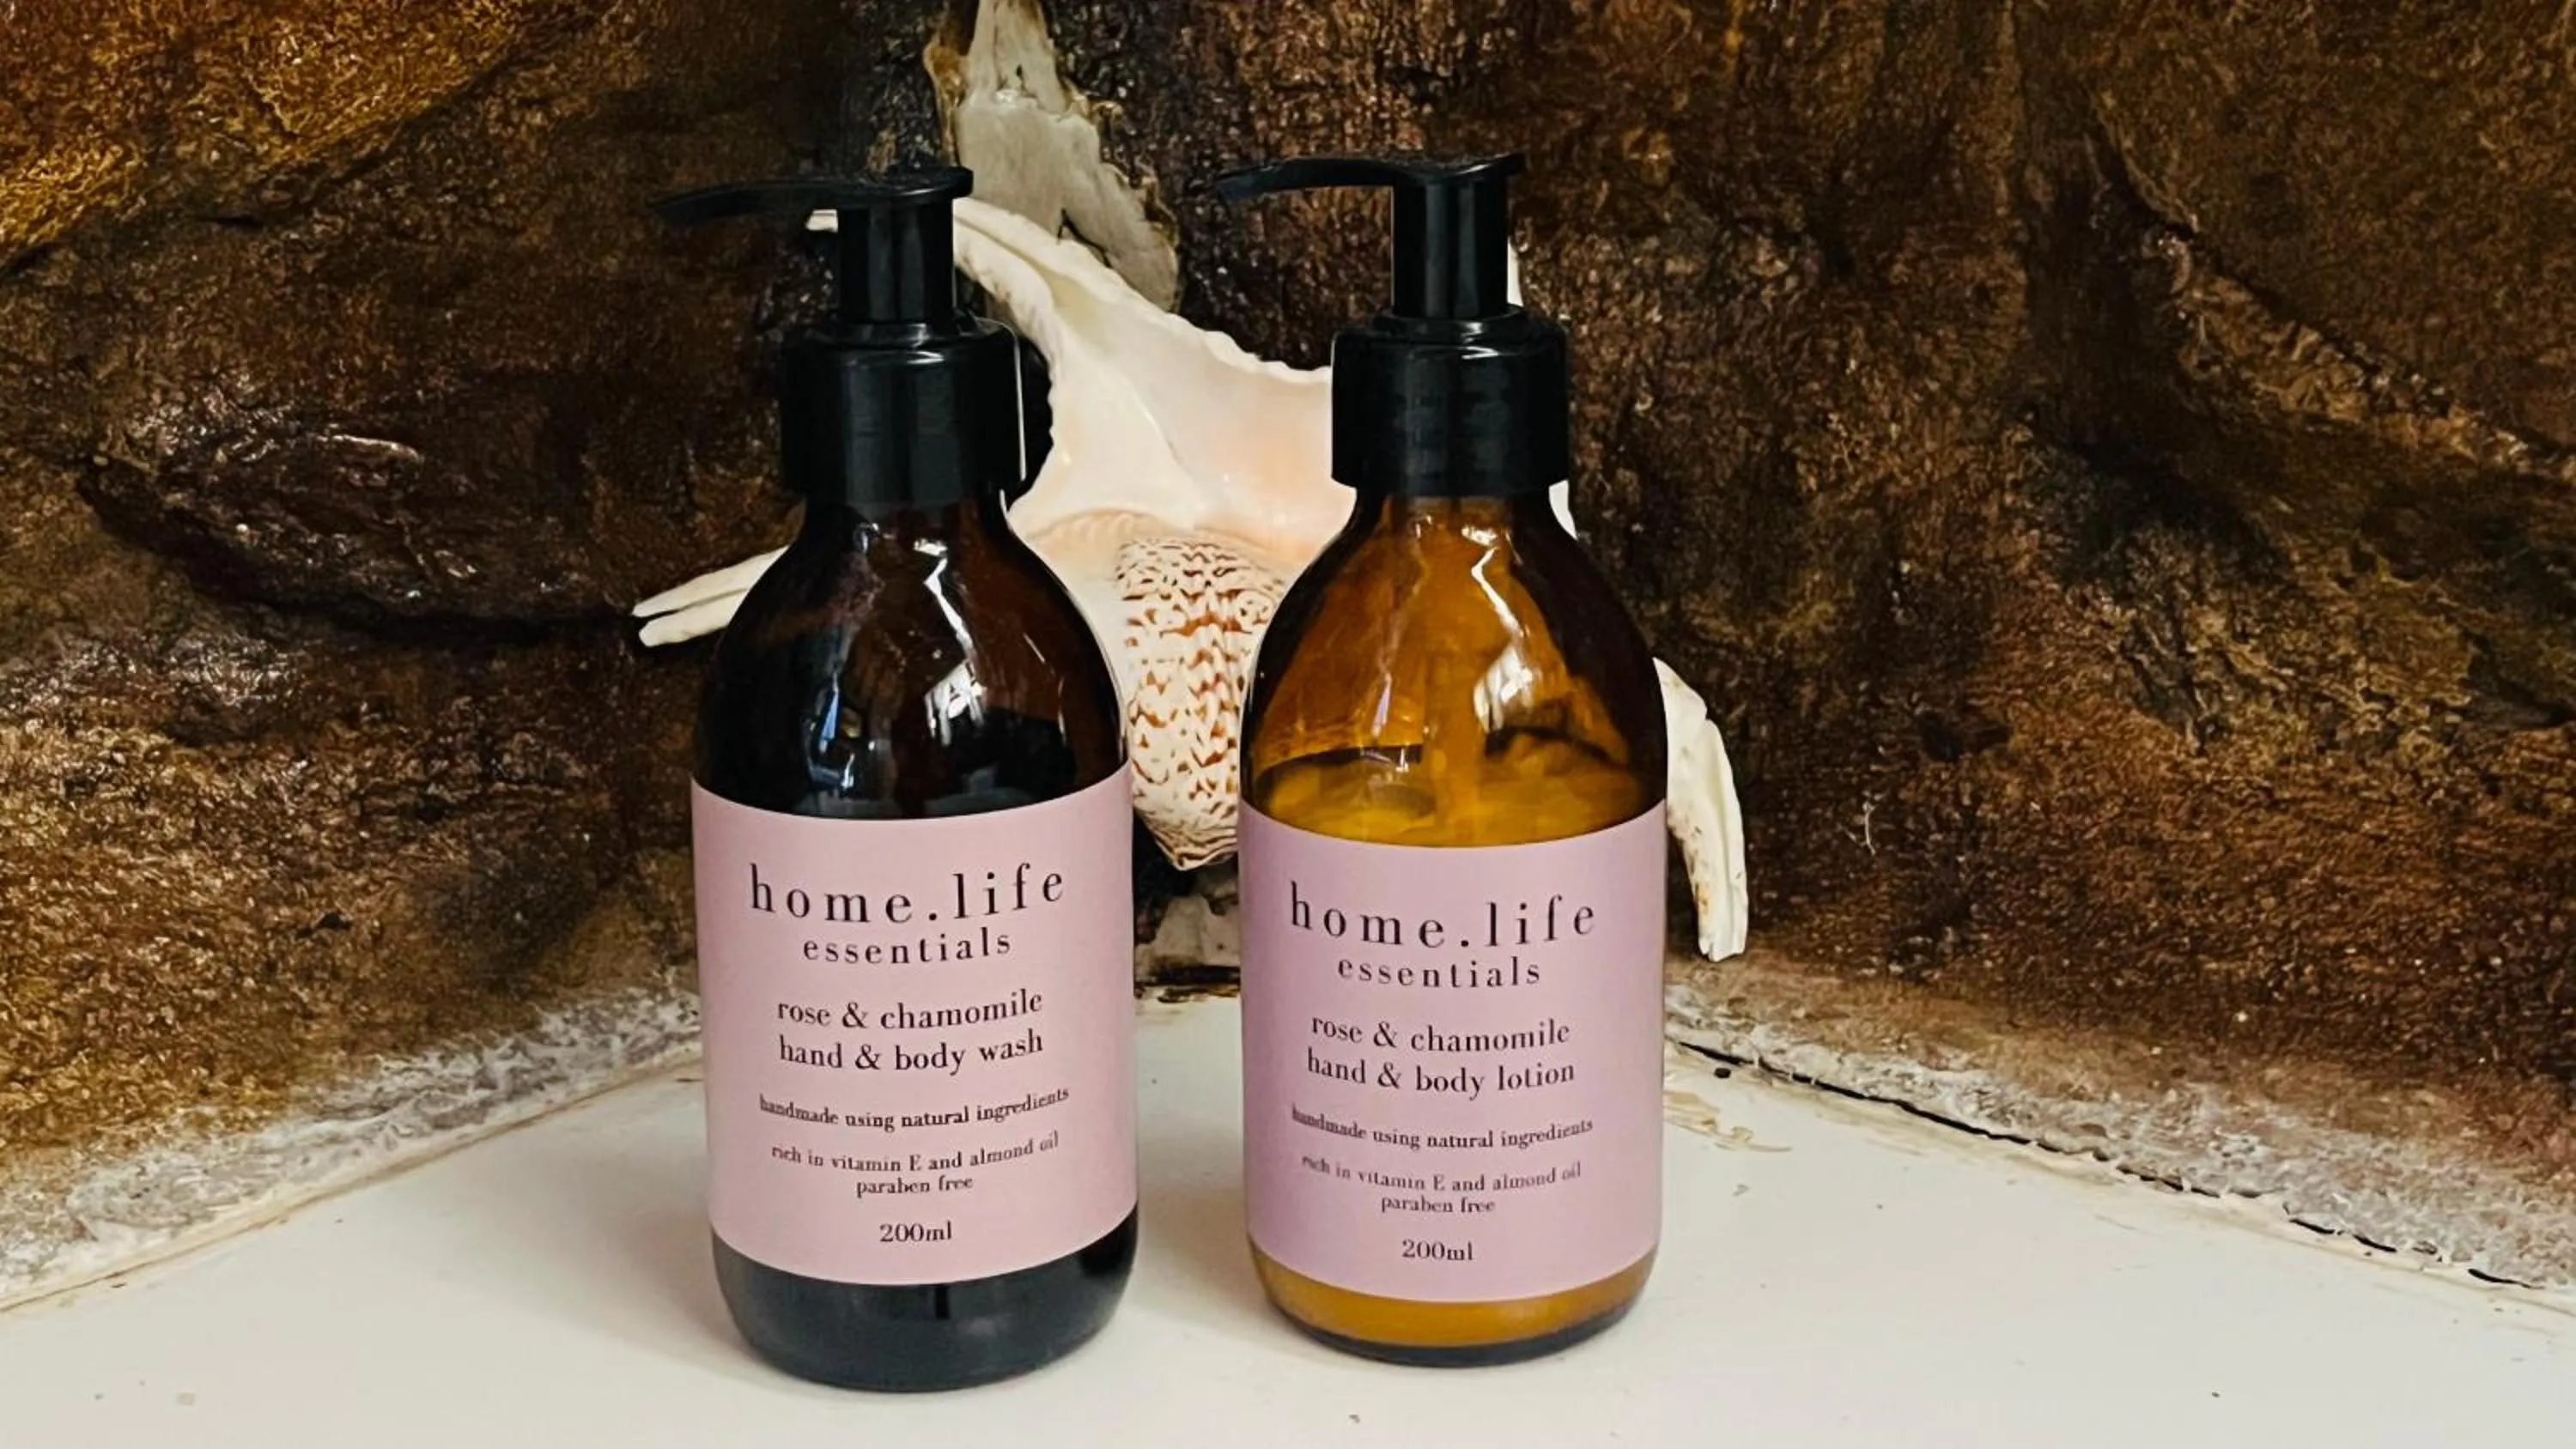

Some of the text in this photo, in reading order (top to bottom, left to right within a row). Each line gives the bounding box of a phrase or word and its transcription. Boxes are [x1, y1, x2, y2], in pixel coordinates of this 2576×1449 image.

[750, 862, 1063, 923] home.life
[1291, 880, 1595, 949] home.life
[803, 925, 1011, 965] essentials
[1337, 955, 1540, 989] essentials
[777, 987, 1042, 1029] rose & chamomile
[779, 1027, 1043, 1077] hand & body wash
[1312, 1016, 1571, 1053] rose & chamomile
[1308, 1046, 1575, 1102] hand & body lotion
[759, 1088, 1070, 1134] handmade using natural ingredients
[1291, 1105, 1594, 1152] handmade using natural ingredients
[771, 1129, 1059, 1173] rich in vitamin E and almond oil
[856, 1173, 974, 1200] paraben free
[1334, 1163, 1352, 1180] in
[1358, 1169, 1425, 1191] vitamin
[1433, 1173, 1445, 1191] E
[1451, 1173, 1485, 1192] and
[1492, 1167, 1557, 1191] almond
[1561, 1160, 1581, 1181] oil
[1381, 1194, 1496, 1214] paraben free
[879, 1219, 953, 1243] 200ml
[1401, 1239, 1473, 1262] 200ml
